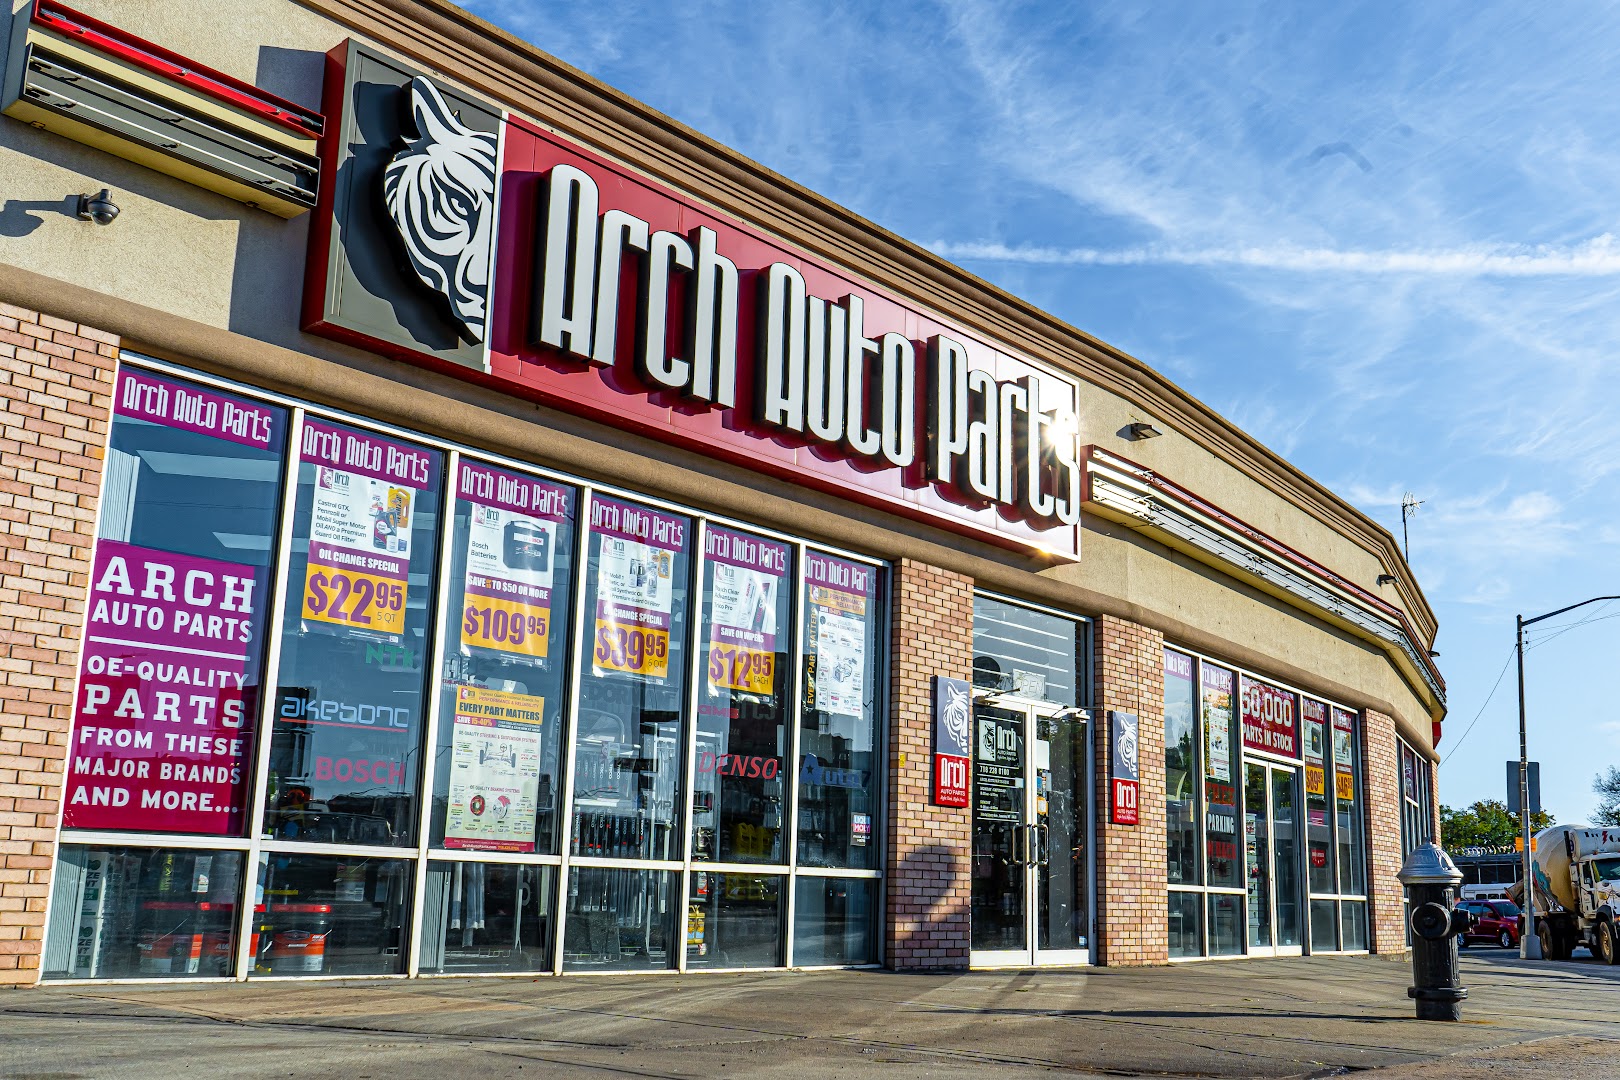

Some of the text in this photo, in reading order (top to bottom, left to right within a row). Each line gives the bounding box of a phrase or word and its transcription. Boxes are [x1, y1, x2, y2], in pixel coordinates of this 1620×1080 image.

[538, 163, 1080, 526] Arch Auto Parts
[122, 377, 272, 443] Arch Auto Parts
[302, 425, 430, 483] Arch Auto Parts
[334, 472, 349, 486] Arch
[461, 466, 568, 517] Arch Auto Parts
[317, 499, 337, 508] Castrol
[486, 508, 499, 521] Arch
[315, 530, 331, 538] Guard
[332, 518, 348, 526] Super
[349, 522, 367, 530] Motor
[341, 528, 367, 538] Premium
[591, 500, 683, 546] Arch Auto Parts
[470, 550, 497, 561] Batteries
[472, 541, 488, 550] Bosch
[613, 540, 625, 552] Arch
[705, 530, 786, 571] Arch Auto Parts
[319, 548, 400, 573] OIL CHANGE SPECIAL
[95, 556, 256, 614] ARCH
[804, 555, 875, 593] Arch Auto Parts
[467, 575, 486, 588] SAVE
[492, 580, 501, 591] TO
[502, 582, 517, 593] $50
[518, 585, 528, 595] OR
[528, 588, 548, 600] MORE
[714, 593, 738, 603] Advantage
[614, 608, 638, 621] CHANGE
[638, 613, 662, 625] SPECIAL
[714, 601, 724, 609] Trico
[91, 598, 253, 643] AUTO PARTS
[376, 612, 396, 624] 5 QT
[720, 627, 764, 643] SAVE ON WIPERS
[366, 641, 418, 668] NTK
[654, 660, 665, 669] QT
[808, 650, 816, 673] PART
[87, 655, 249, 691] OE-QUALITY
[753, 675, 769, 685] EACH
[82, 684, 245, 728] PARTS
[459, 702, 540, 721] EVERY PART MATTERS
[1242, 685, 1292, 727] 50,000
[457, 716, 471, 724] SAVE
[80, 726, 243, 757] FROM THESE
[996, 725, 1016, 751] Arch
[1243, 724, 1293, 752] PARTS IN STOCK
[74, 756, 241, 785] MAJOR BRANDS
[315, 756, 404, 786] BOSCH
[698, 752, 778, 779] DENSO
[800, 752, 862, 788] Auto
[941, 757, 966, 789] Arch
[71, 785, 238, 813] AND MORE...
[1116, 782, 1136, 808] Arch
[853, 824, 870, 832] MOLY
[1208, 813, 1235, 834] PARKING
[1216, 841, 1237, 860] BACK
